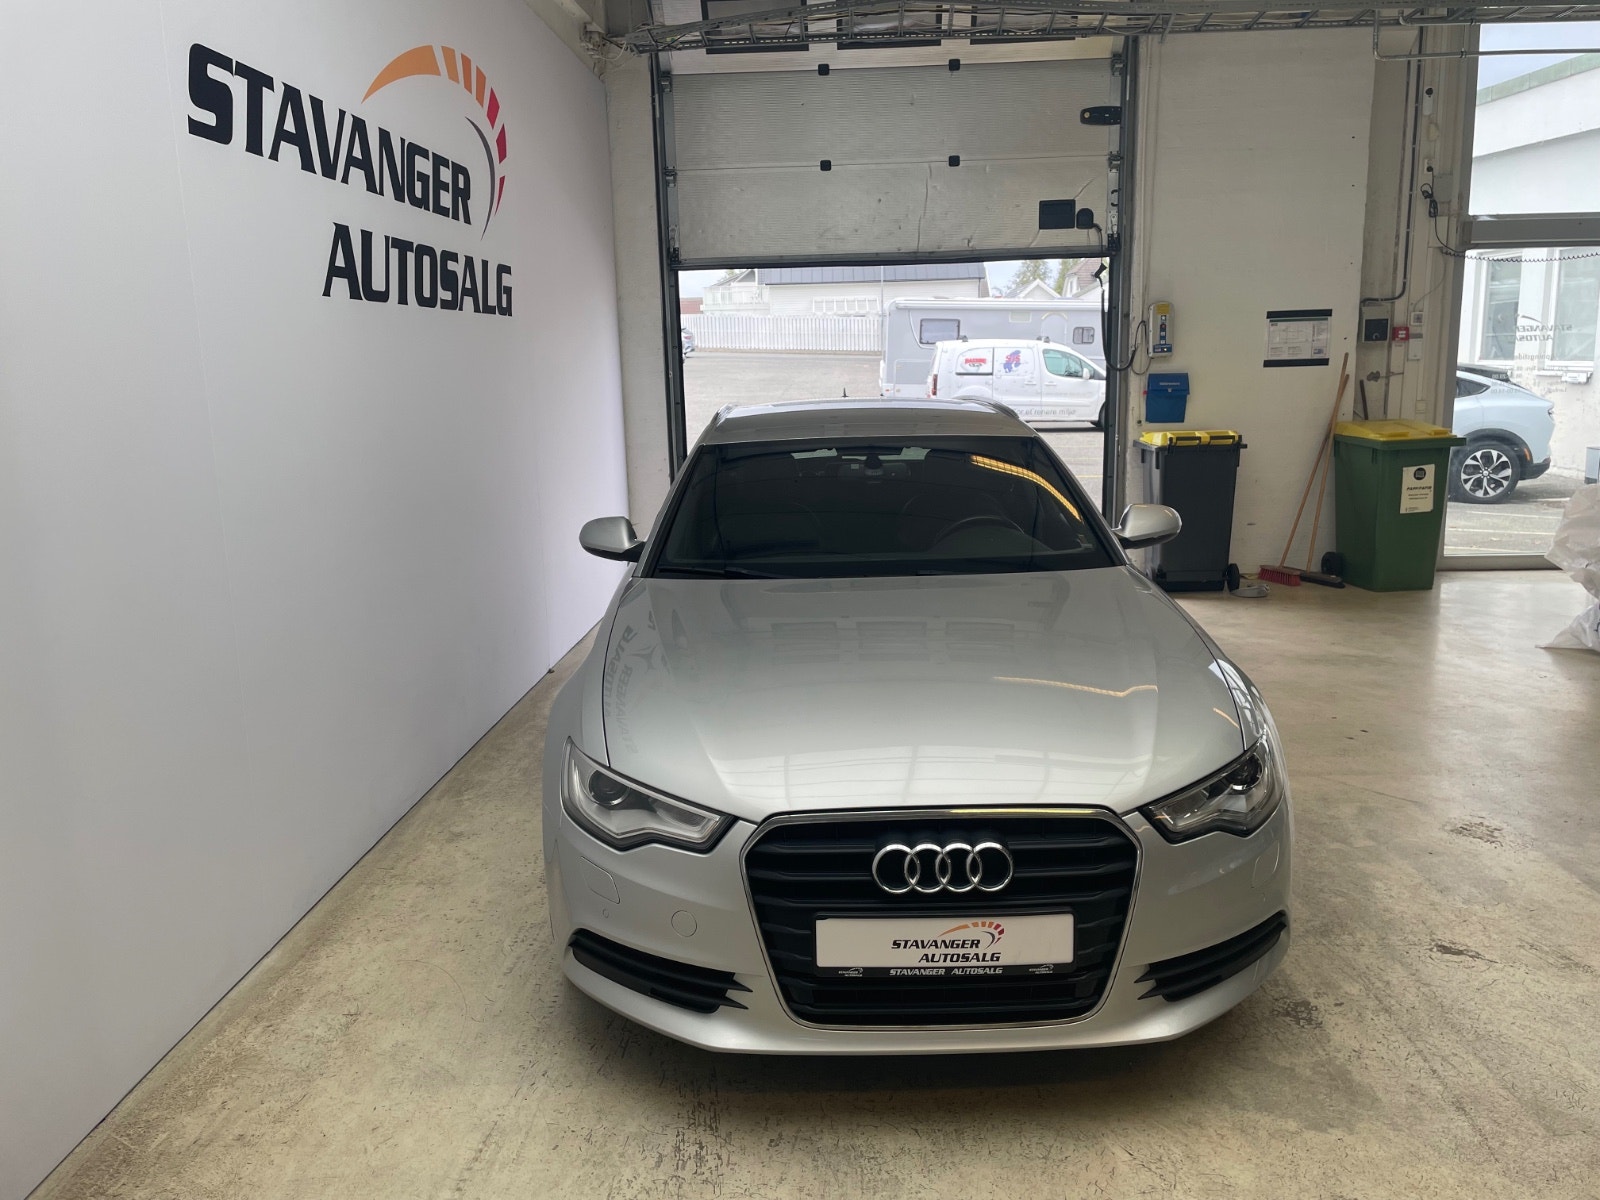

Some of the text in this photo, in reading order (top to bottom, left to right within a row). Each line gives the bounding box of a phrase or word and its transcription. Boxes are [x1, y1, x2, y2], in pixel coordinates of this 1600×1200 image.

[188, 43, 472, 225] STAVANGER
[322, 222, 513, 317] AUTOSALG
[891, 939, 981, 950] STAVANGER
[918, 952, 1002, 963] AUTOSALG
[889, 967, 1003, 976] STAVANGER AUTOSALG
